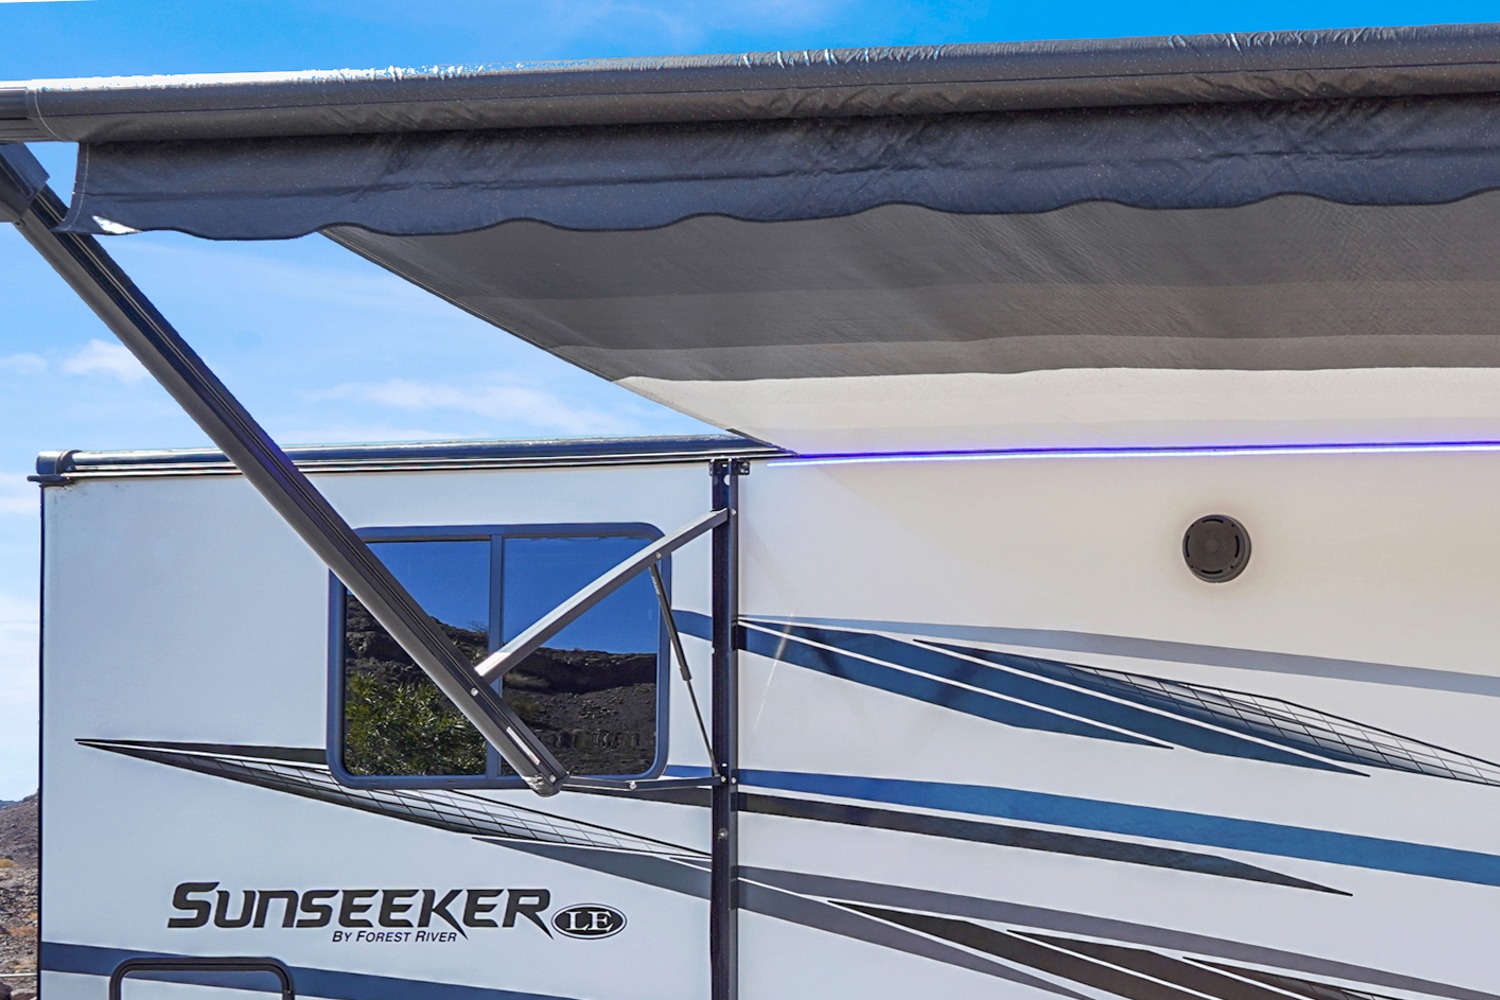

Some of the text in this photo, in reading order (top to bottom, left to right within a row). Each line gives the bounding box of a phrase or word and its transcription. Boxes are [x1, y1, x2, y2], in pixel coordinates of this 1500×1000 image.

[565, 911, 614, 932] LE
[355, 931, 411, 943] FOREST
[414, 931, 457, 943] RIVER
